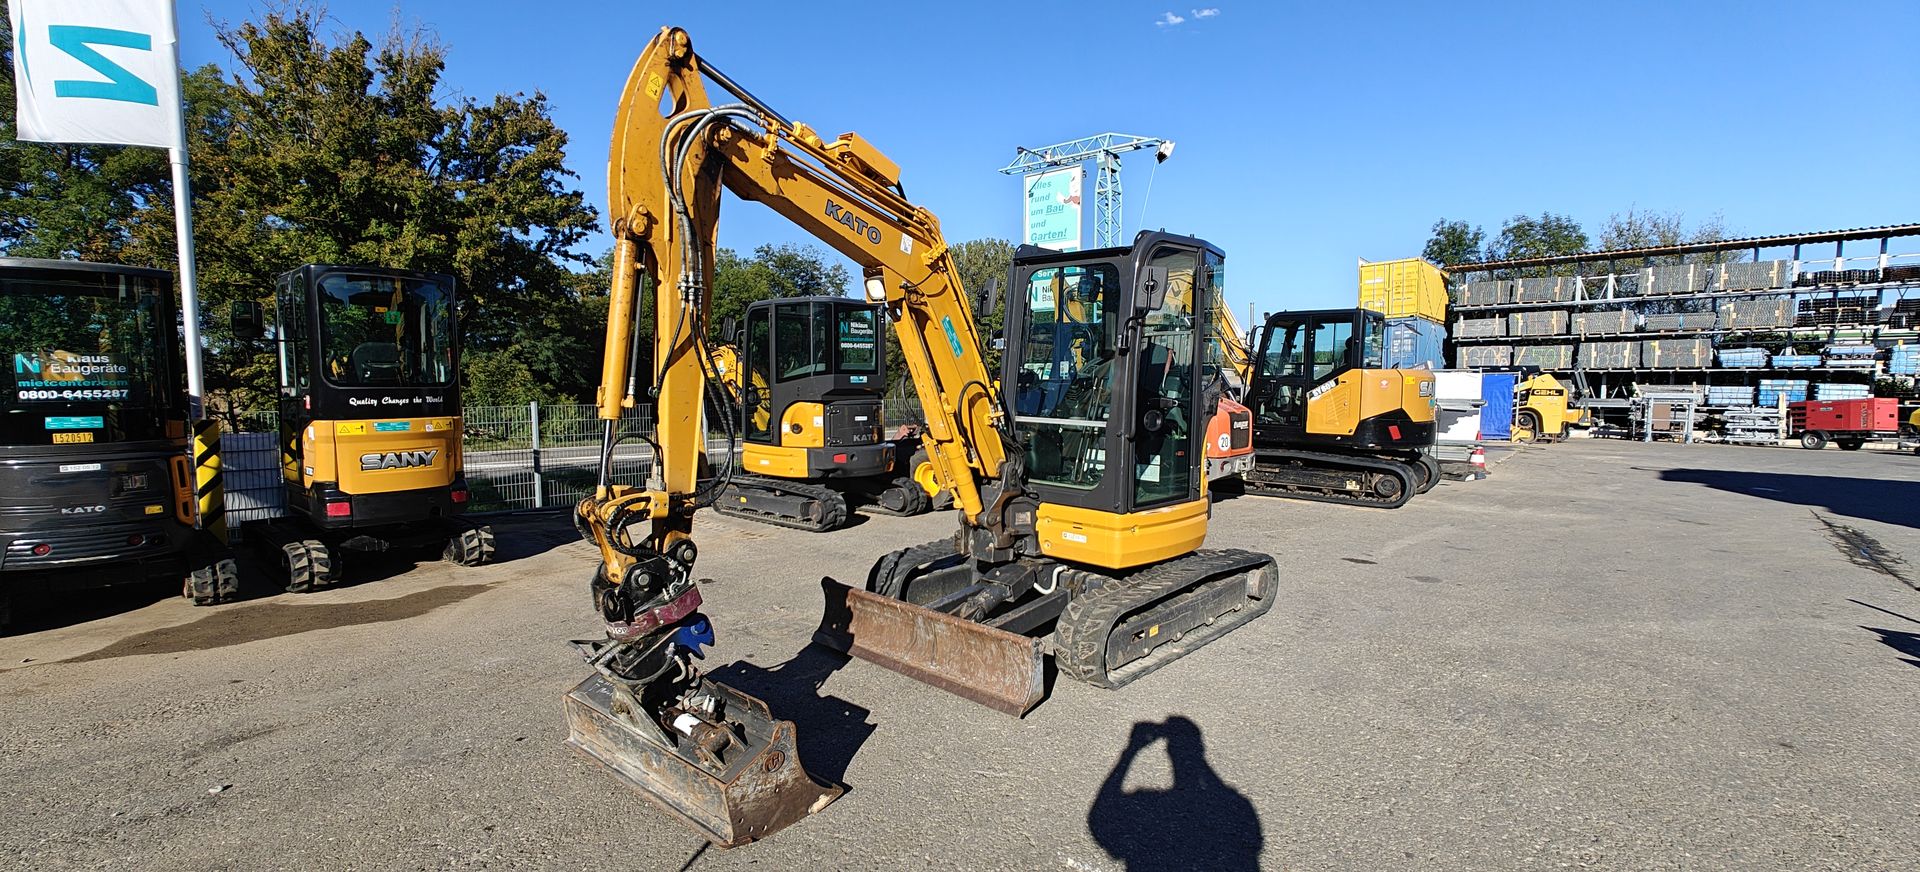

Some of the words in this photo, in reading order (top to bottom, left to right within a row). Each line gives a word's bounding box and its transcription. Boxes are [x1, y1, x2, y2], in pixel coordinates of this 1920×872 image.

[1031, 193, 1051, 203] rund
[1045, 204, 1065, 215] Bau
[825, 198, 882, 245] KATO
[1031, 219, 1046, 228] und
[1031, 228, 1067, 241] Garten!
[51, 363, 127, 375] Baugeräte
[18, 379, 129, 387] mietcenter.com
[18, 389, 129, 399] 0800-6455287
[349, 397, 378, 406] Quality
[381, 396, 409, 406] Changes
[54, 434, 92, 443] 1520512
[1220, 436, 1229, 448] 20
[360, 450, 439, 471] SANY
[61, 505, 106, 514] KATO
